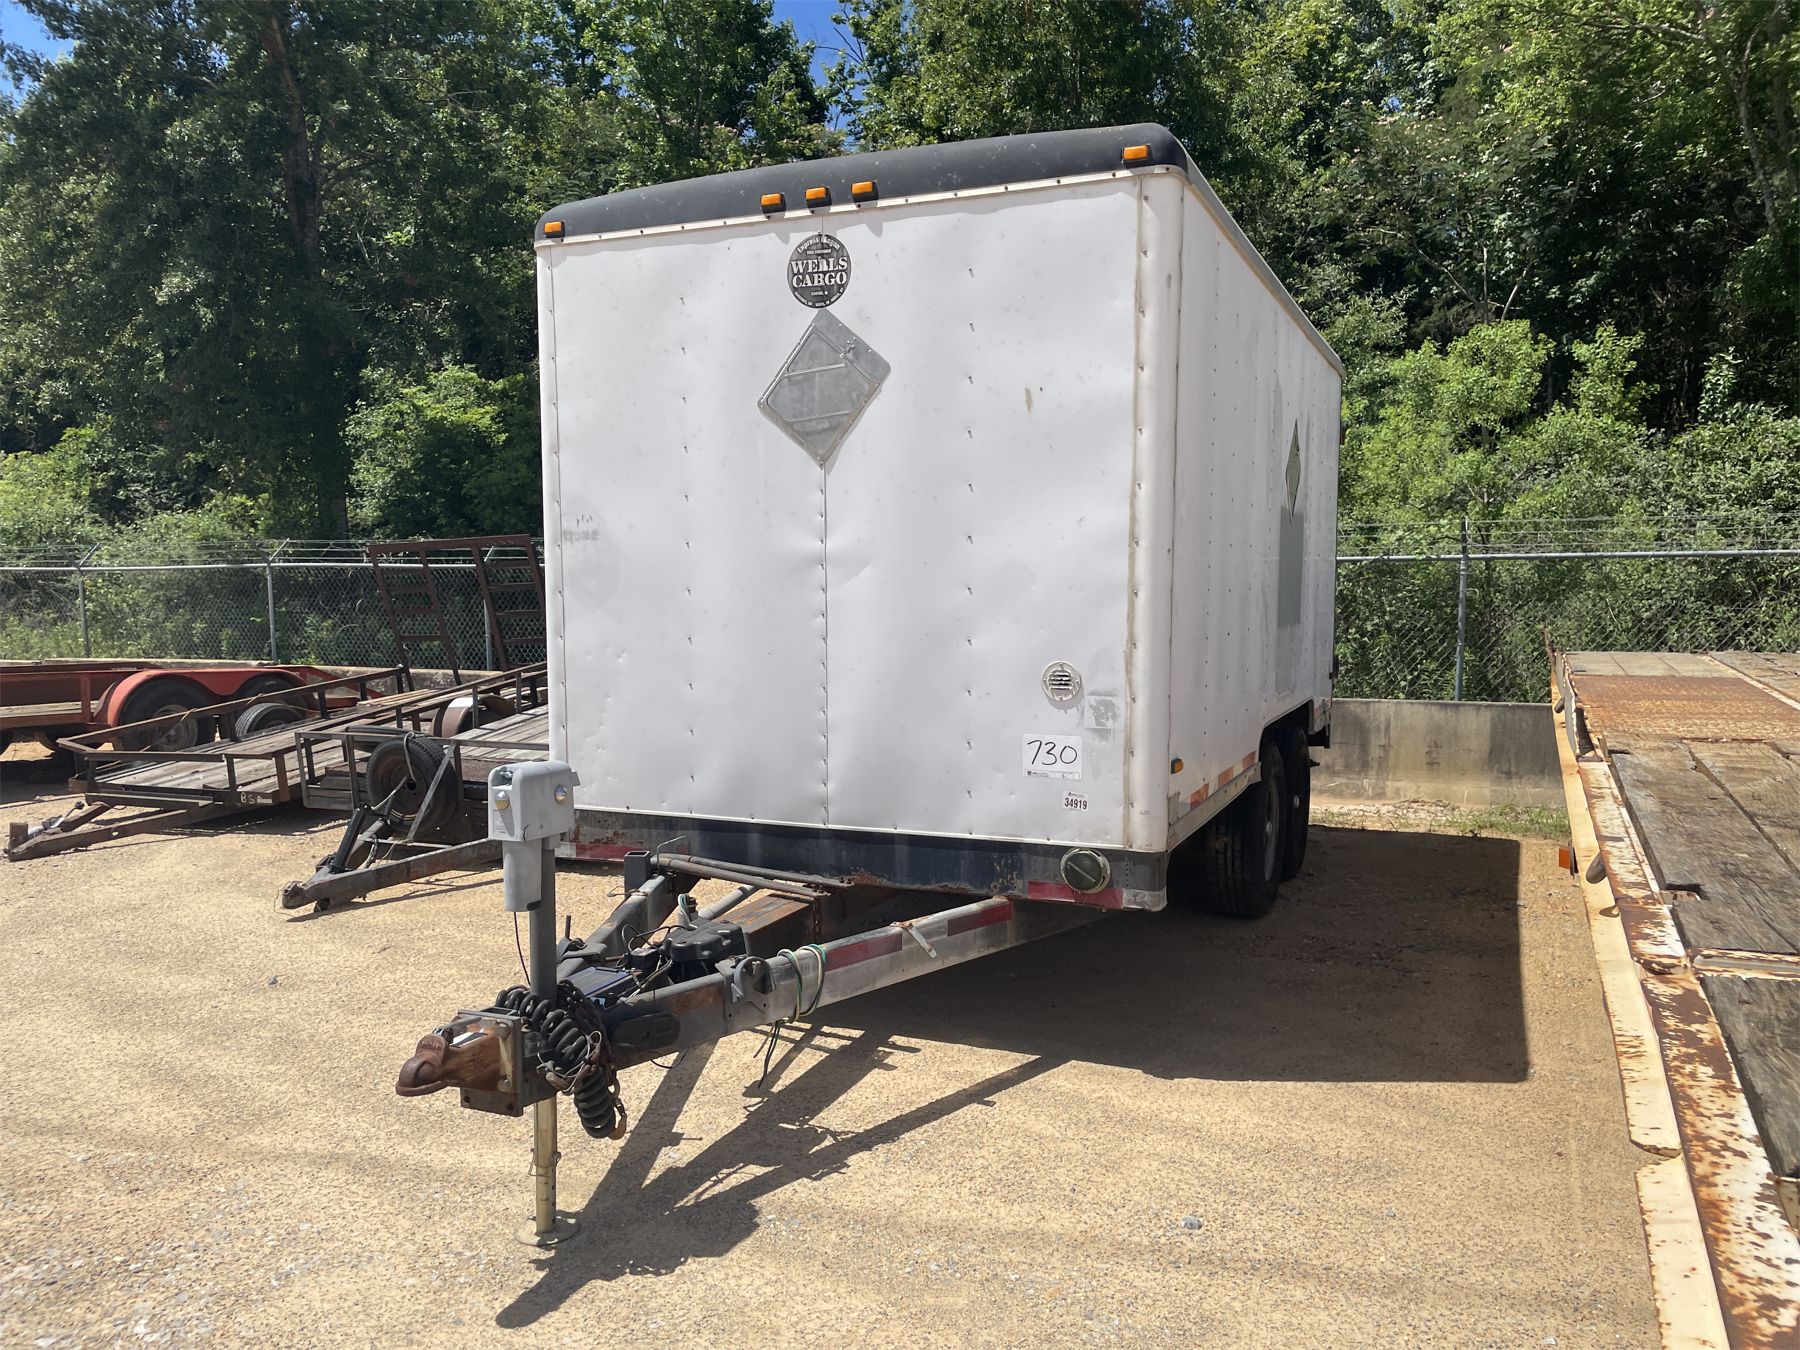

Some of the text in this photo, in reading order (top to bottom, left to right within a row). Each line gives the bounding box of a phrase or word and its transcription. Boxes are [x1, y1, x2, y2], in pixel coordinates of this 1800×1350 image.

[790, 256, 848, 274] WELLS
[792, 271, 847, 288] CARGO
[1026, 739, 1078, 766] 730
[1064, 797, 1088, 810] 34919
